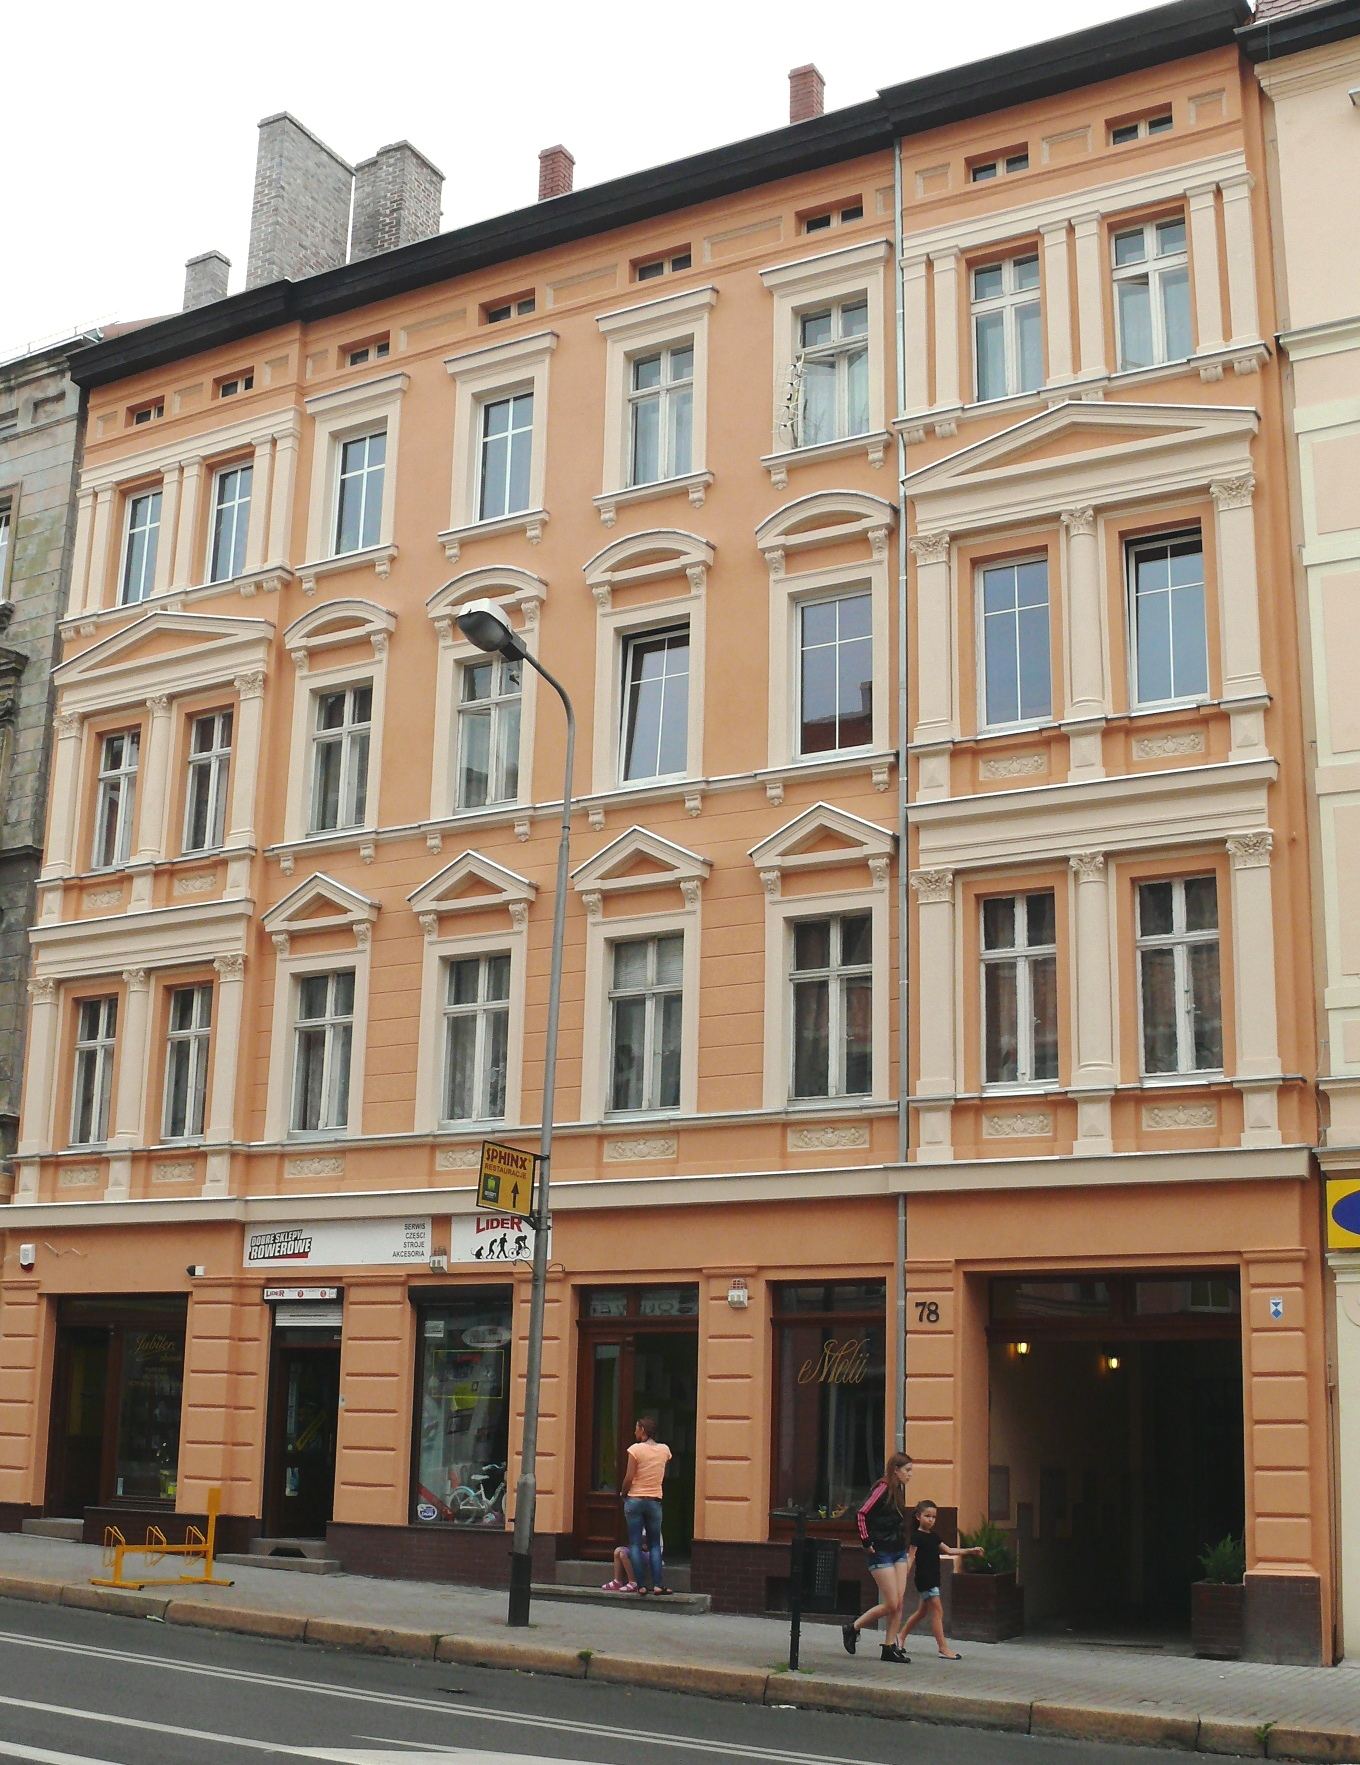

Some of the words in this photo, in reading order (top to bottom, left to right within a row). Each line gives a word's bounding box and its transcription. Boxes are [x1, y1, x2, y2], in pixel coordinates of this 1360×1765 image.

[485, 1147, 528, 1171] SPHINX
[484, 1162, 527, 1179] RESTAURACJE
[404, 1222, 426, 1231] SERWIS
[475, 1216, 523, 1234] LIDER
[274, 1230, 304, 1243] SKLEPY
[249, 1238, 312, 1260] ROWEROWE
[403, 1241, 425, 1249] STROJE
[392, 1250, 425, 1258] AKCESORIA
[265, 1289, 285, 1297] LIDER
[914, 1301, 940, 1323] 78
